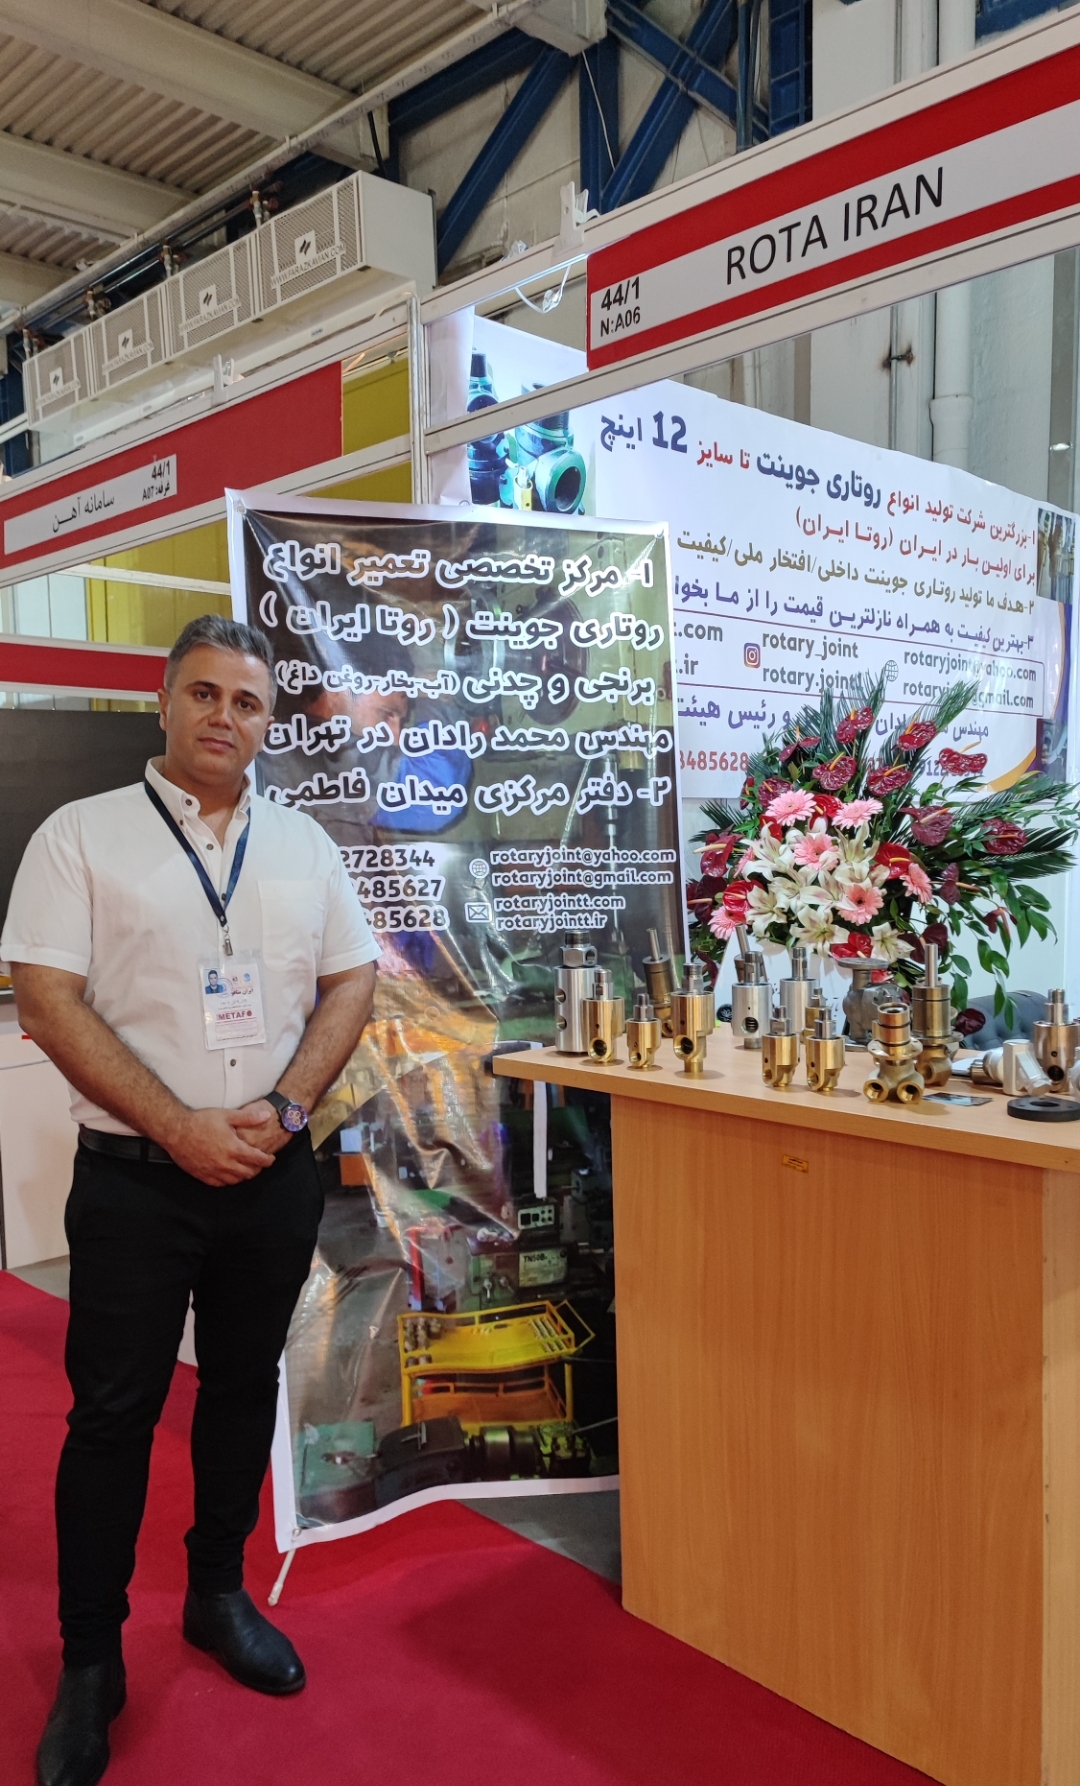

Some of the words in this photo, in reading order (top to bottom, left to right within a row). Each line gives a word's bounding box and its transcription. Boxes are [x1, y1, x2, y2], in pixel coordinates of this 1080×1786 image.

[726, 215, 828, 286] ROTA
[843, 166, 944, 242] IRAN
[601, 276, 641, 311] 44/1
[600, 306, 641, 338] N:A06
[600, 414, 643, 452] اینچ
[652, 410, 688, 453] 12
[696, 440, 733, 468] سایز
[740, 449, 751, 469] تا
[151, 460, 170, 480] 44/1
[757, 452, 820, 495] جوینت
[84, 491, 115, 514] سامانه
[826, 470, 881, 509] روتاری
[887, 491, 919, 517] انواع
[925, 500, 954, 522] تولید
[957, 508, 986, 532] شرکت
[267, 544, 338, 580] انواع
[899, 535, 942, 562] ایران
[946, 548, 958, 564] در
[961, 548, 979, 572] بار
[350, 553, 428, 583] تعمیر
[438, 557, 552, 586] تخصصی
[561, 559, 620, 594] مرکز
[864, 568, 908, 596] جوینت
[982, 557, 1012, 580] اولین
[674, 575, 709, 607] بخوا
[716, 581, 739, 605] ما
[746, 588, 759, 612] از
[765, 590, 778, 616] را
[914, 578, 956, 603] روتاری
[959, 587, 982, 608] تولید
[986, 590, 995, 608] ما
[289, 603, 367, 638] ایران
[783, 595, 824, 623] قیمت
[379, 608, 433, 642] روتا
[468, 615, 560, 647] جوینت
[573, 615, 661, 647] روتاری
[896, 613, 940, 637] همراه
[945, 622, 954, 643] به
[957, 624, 991, 649] کیفیت
[762, 632, 859, 661] rotary_joint
[466, 671, 539, 707] چدنی
[550, 677, 566, 699] و
[578, 671, 651, 702] برنجی
[728, 699, 776, 729] رئیس
[264, 718, 346, 751] تهران
[360, 726, 390, 750] در
[403, 724, 483, 755] رادان
[495, 730, 567, 748] محمد
[579, 727, 670, 757] مهندس
[269, 771, 367, 808] فاطمی
[381, 779, 464, 812] میدان
[478, 777, 567, 812] مرکزی
[578, 775, 631, 811] دفتر
[340, 848, 436, 869] 2728344
[491, 846, 676, 866] rotaryjoint@yahoo.com
[356, 879, 442, 899] 485627
[493, 868, 672, 888] rotaryjoint@gmail.com
[495, 893, 625, 913] rotaryjointt.com
[498, 913, 606, 933] rotaryjointt.ir
